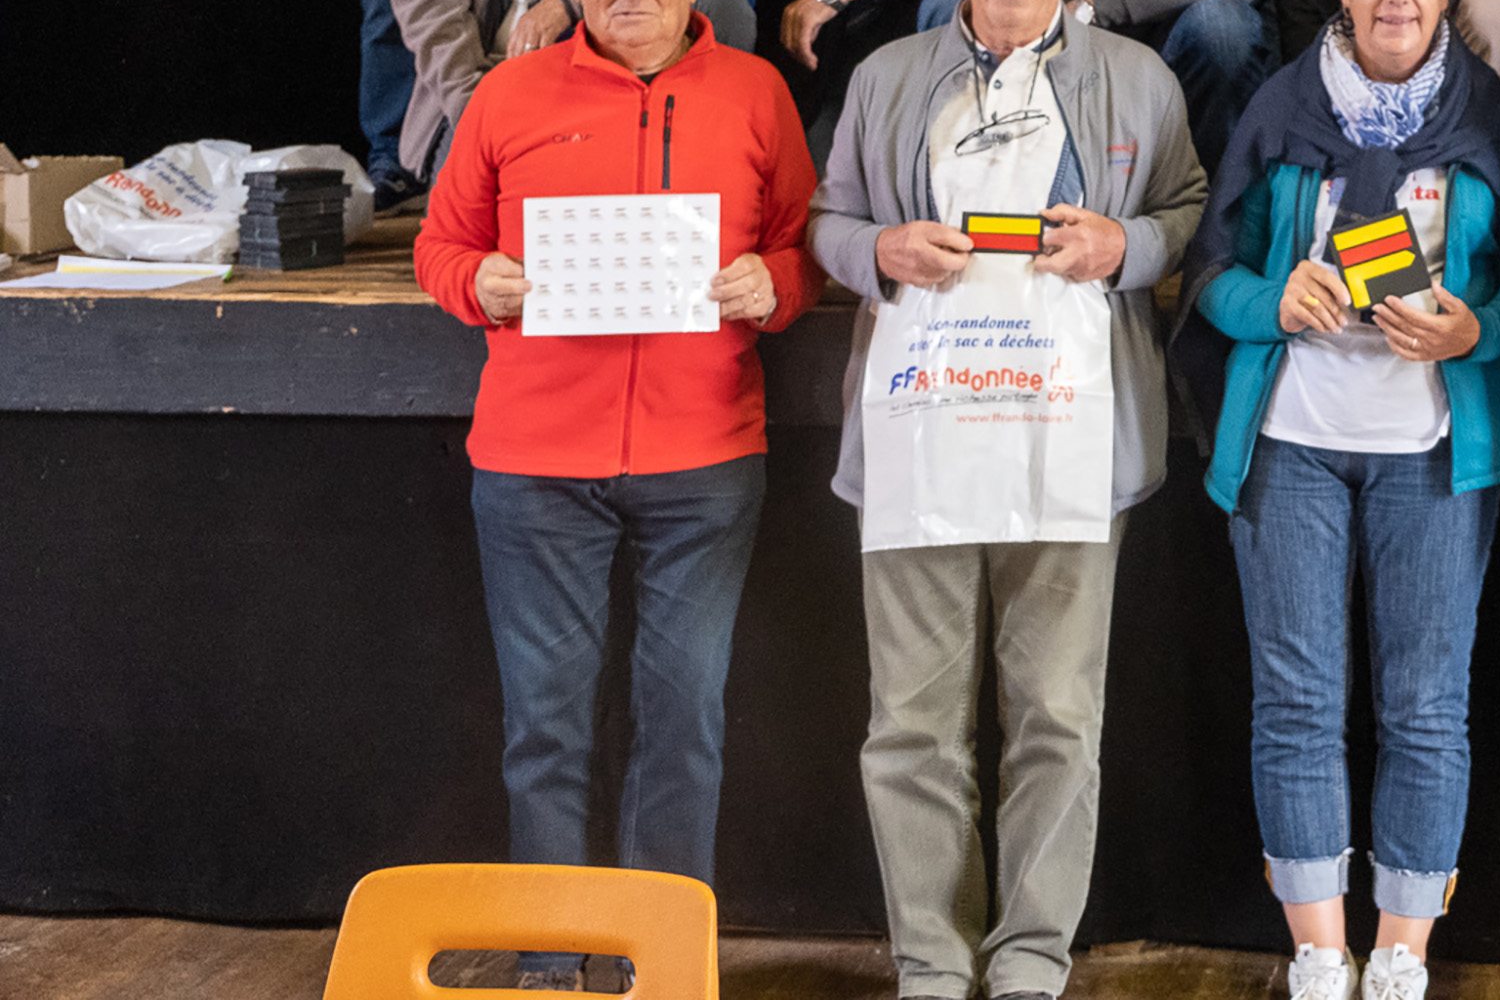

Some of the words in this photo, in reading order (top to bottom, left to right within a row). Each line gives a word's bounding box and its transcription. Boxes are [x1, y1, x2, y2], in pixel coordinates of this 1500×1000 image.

[1411, 185, 1440, 200] ta
[955, 336, 980, 348] sac
[984, 335, 994, 348] à
[999, 334, 1055, 349] déchets
